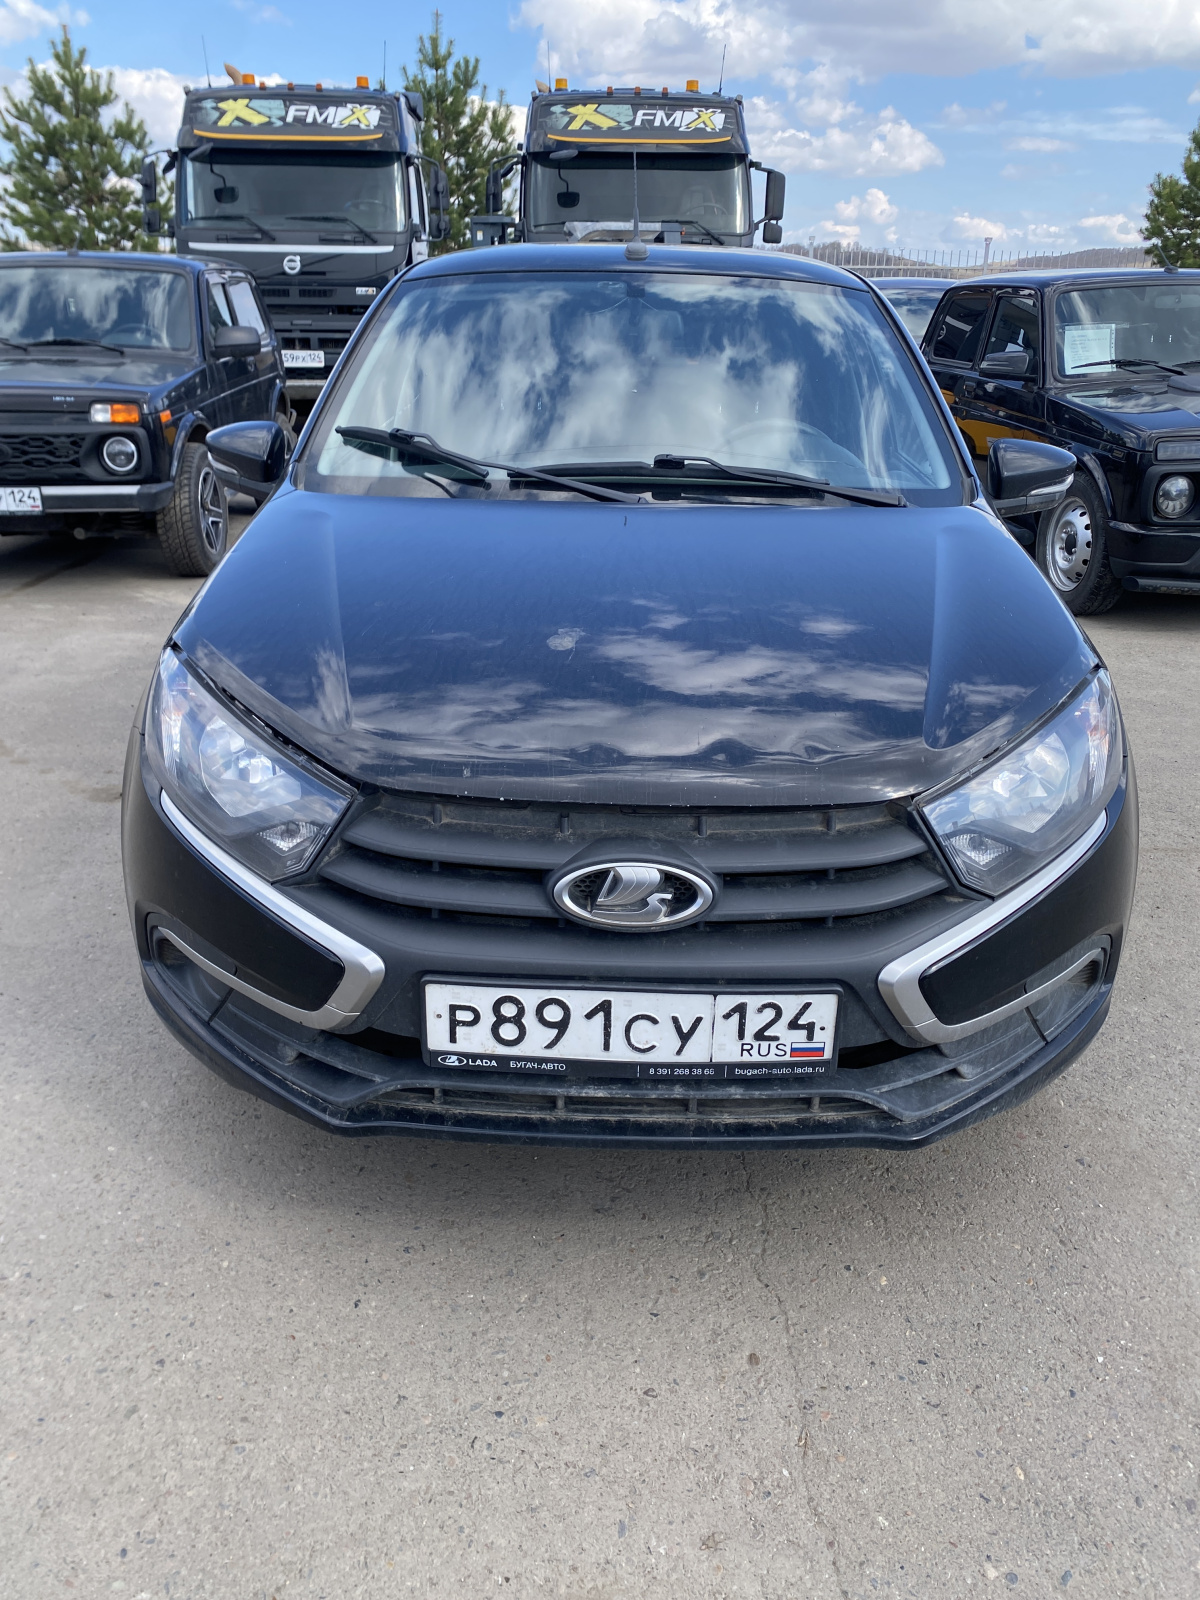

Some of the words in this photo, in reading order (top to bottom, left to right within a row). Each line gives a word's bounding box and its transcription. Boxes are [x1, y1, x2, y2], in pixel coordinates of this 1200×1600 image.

[285, 103, 381, 129] FMX
[634, 108, 725, 132] FMX
[9, 489, 36, 503] 124
[722, 1001, 815, 1041] 124
[740, 1042, 787, 1057] RUS
[469, 1059, 497, 1067] LADA
[510, 1060, 566, 1071] БУГАЧ-АВТО
[649, 1067, 655, 1075] 8
[735, 1066, 825, 1076] bugach-auto.lada.ru
